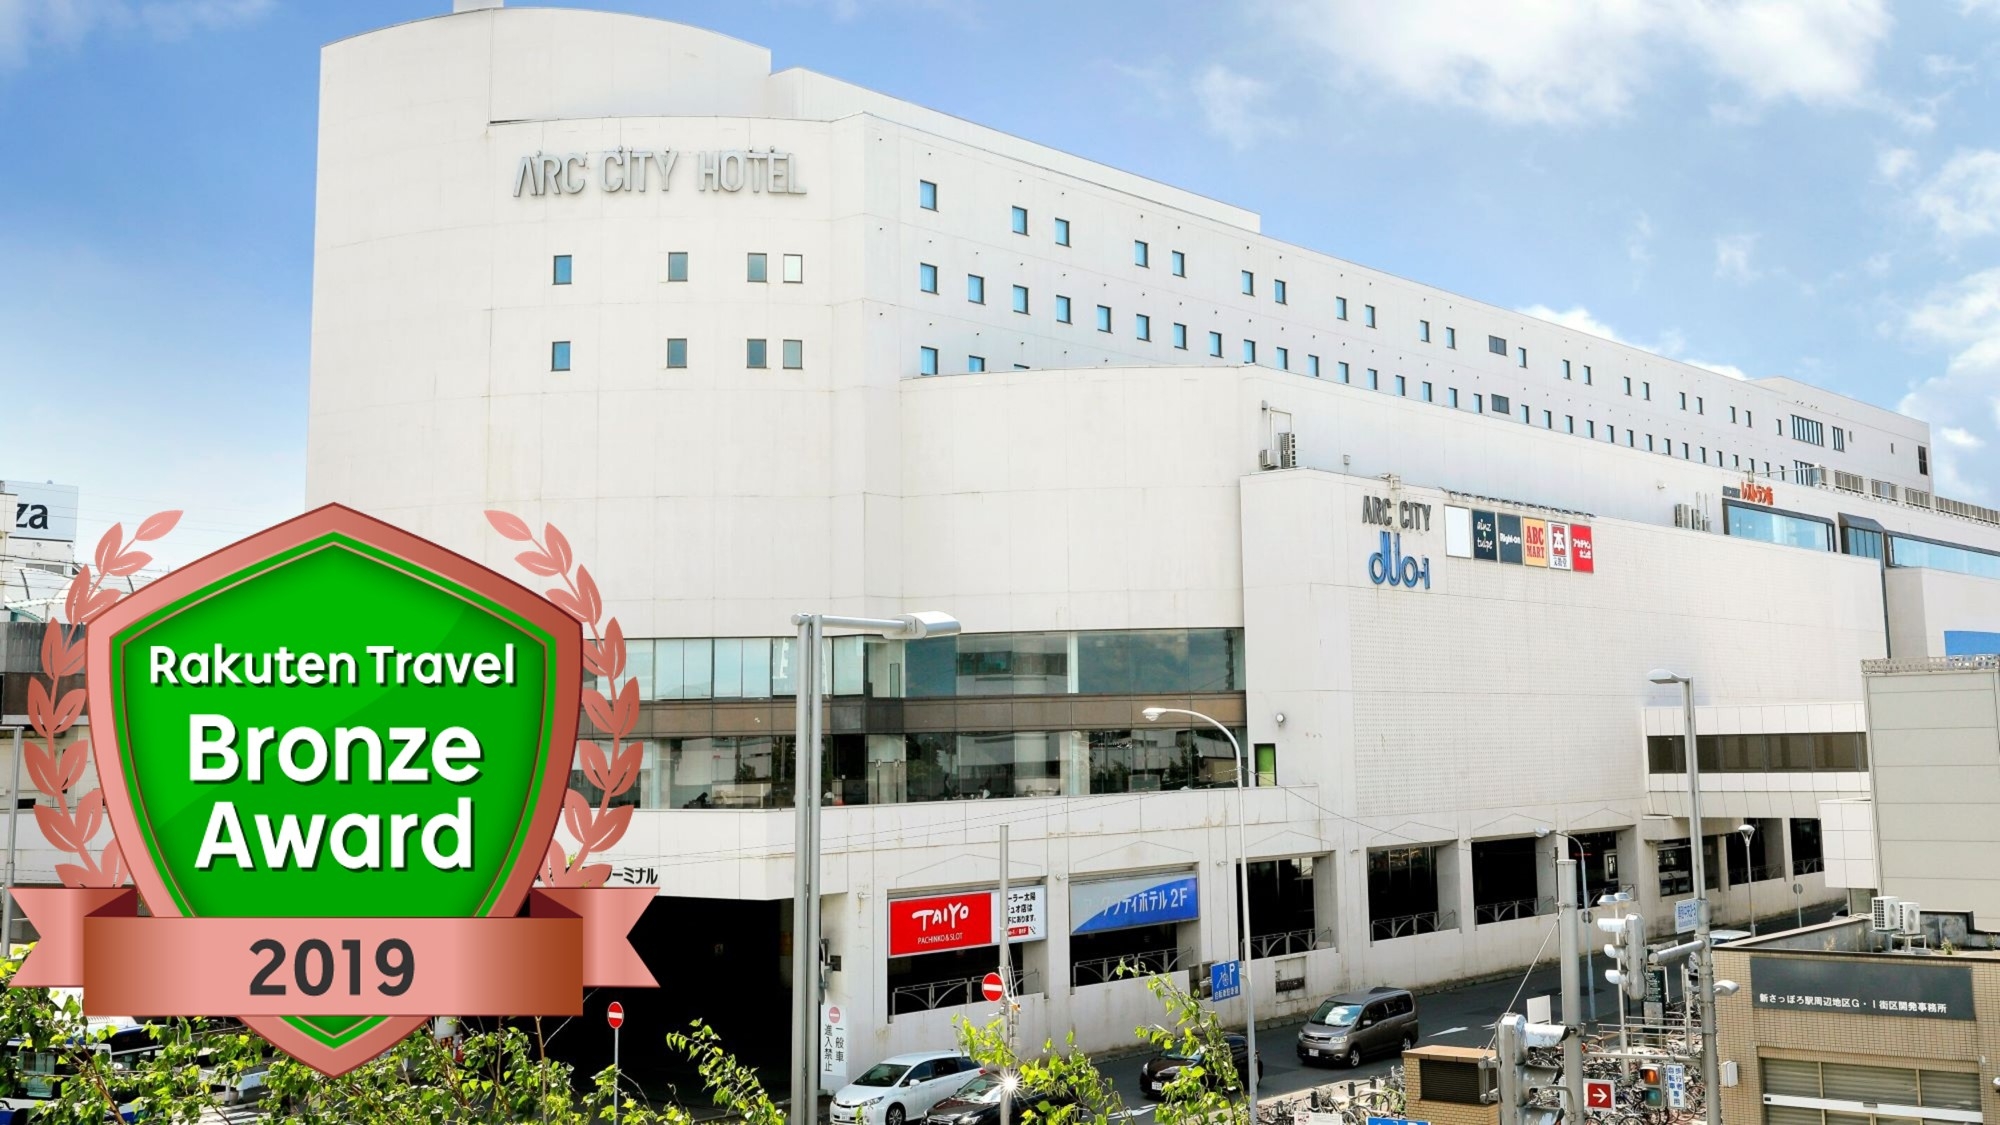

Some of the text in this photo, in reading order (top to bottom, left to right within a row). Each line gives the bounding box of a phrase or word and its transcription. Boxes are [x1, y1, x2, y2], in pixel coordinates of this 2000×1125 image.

[512, 149, 807, 197] ARC CITY HOTEL
[1362, 495, 1432, 531] ARC CITY
[1526, 525, 1545, 546] ABC
[1526, 545, 1545, 559] MART
[606, 866, 659, 885] ーミナル
[1170, 887, 1188, 907] 2F
[911, 902, 969, 931] TAIYO
[824, 1023, 833, 1072] 進入禁止
[835, 1027, 844, 1062] 一般車
